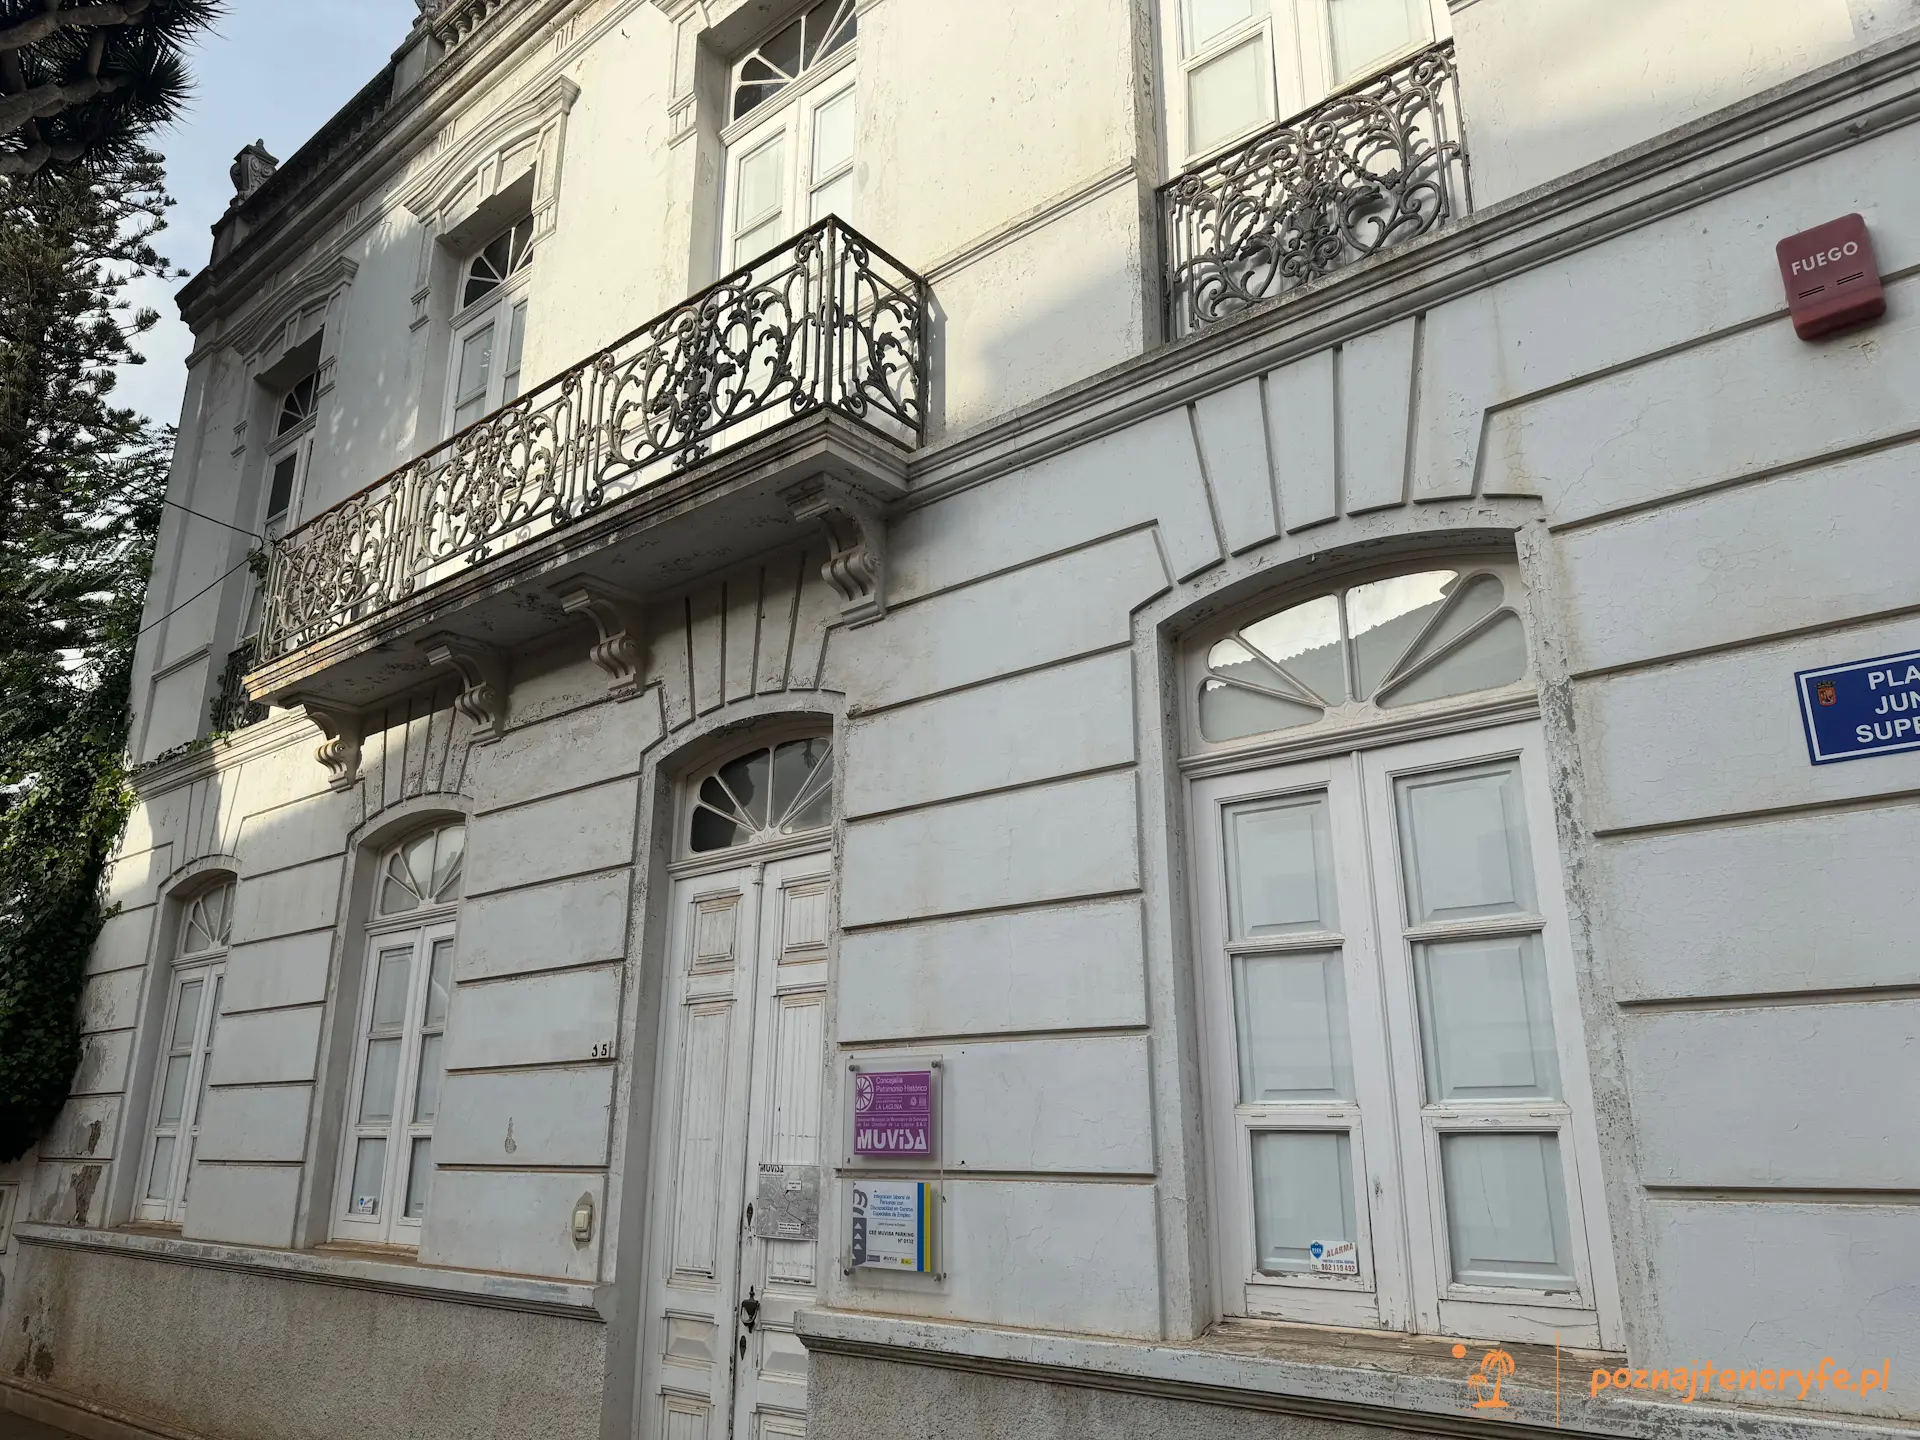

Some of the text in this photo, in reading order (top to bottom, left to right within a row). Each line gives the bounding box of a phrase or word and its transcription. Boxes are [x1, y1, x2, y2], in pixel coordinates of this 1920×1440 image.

[1791, 241, 1858, 276] FUEGO
[1867, 665, 1920, 690] PLA
[875, 1085, 904, 1093] Patrimonio
[1326, 1243, 1354, 1258] ALARMA
